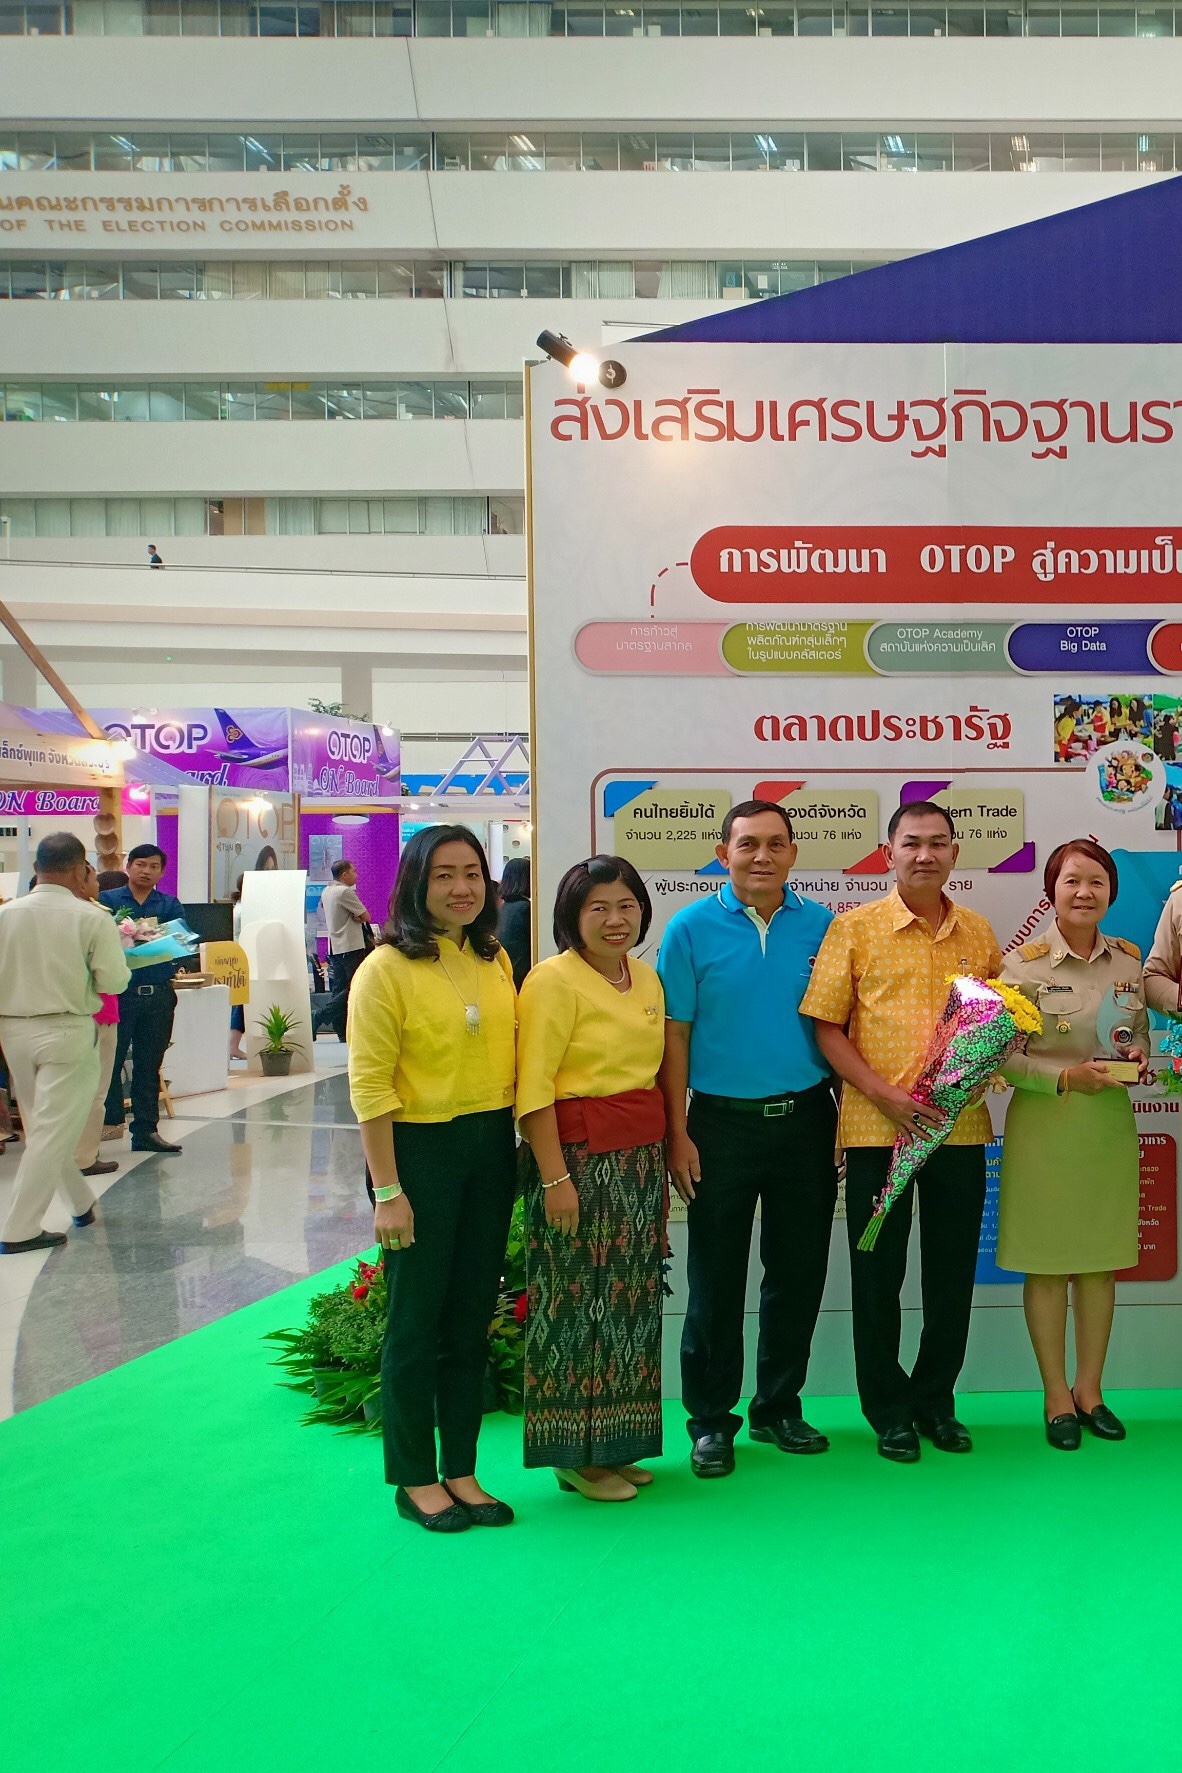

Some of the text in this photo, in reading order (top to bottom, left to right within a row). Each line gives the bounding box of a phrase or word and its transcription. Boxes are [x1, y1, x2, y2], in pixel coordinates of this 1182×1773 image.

[0, 219, 354, 232] OF THE ELECTION COMMISSION
[719, 541, 888, 574] การพัฒนา
[919, 544, 1016, 574] OTOP
[630, 625, 678, 640] การก้าวสู่
[897, 628, 983, 641] OTOP Academy
[1066, 626, 1100, 638] OTOP
[616, 640, 693, 654] มาตรฐานสากล
[1060, 640, 1107, 653] Big Data
[754, 704, 1012, 750] ตลาดประชารัฐ
[327, 730, 373, 763] OTOP
[345, 771, 380, 797] Board
[632, 800, 716, 820] คนไทยยิ้มได้
[944, 804, 1018, 818] dern Trade
[625, 827, 723, 842] จำนวน 2,225 แห่ง
[822, 830, 837, 841] 76
[841, 827, 862, 841] แห่ง
[968, 828, 983, 839] 76
[986, 826, 1008, 840] แห่ง
[789, 876, 839, 892] จำหน่าย
[845, 876, 888, 892] จำนวน
[948, 878, 973, 891] ราย
